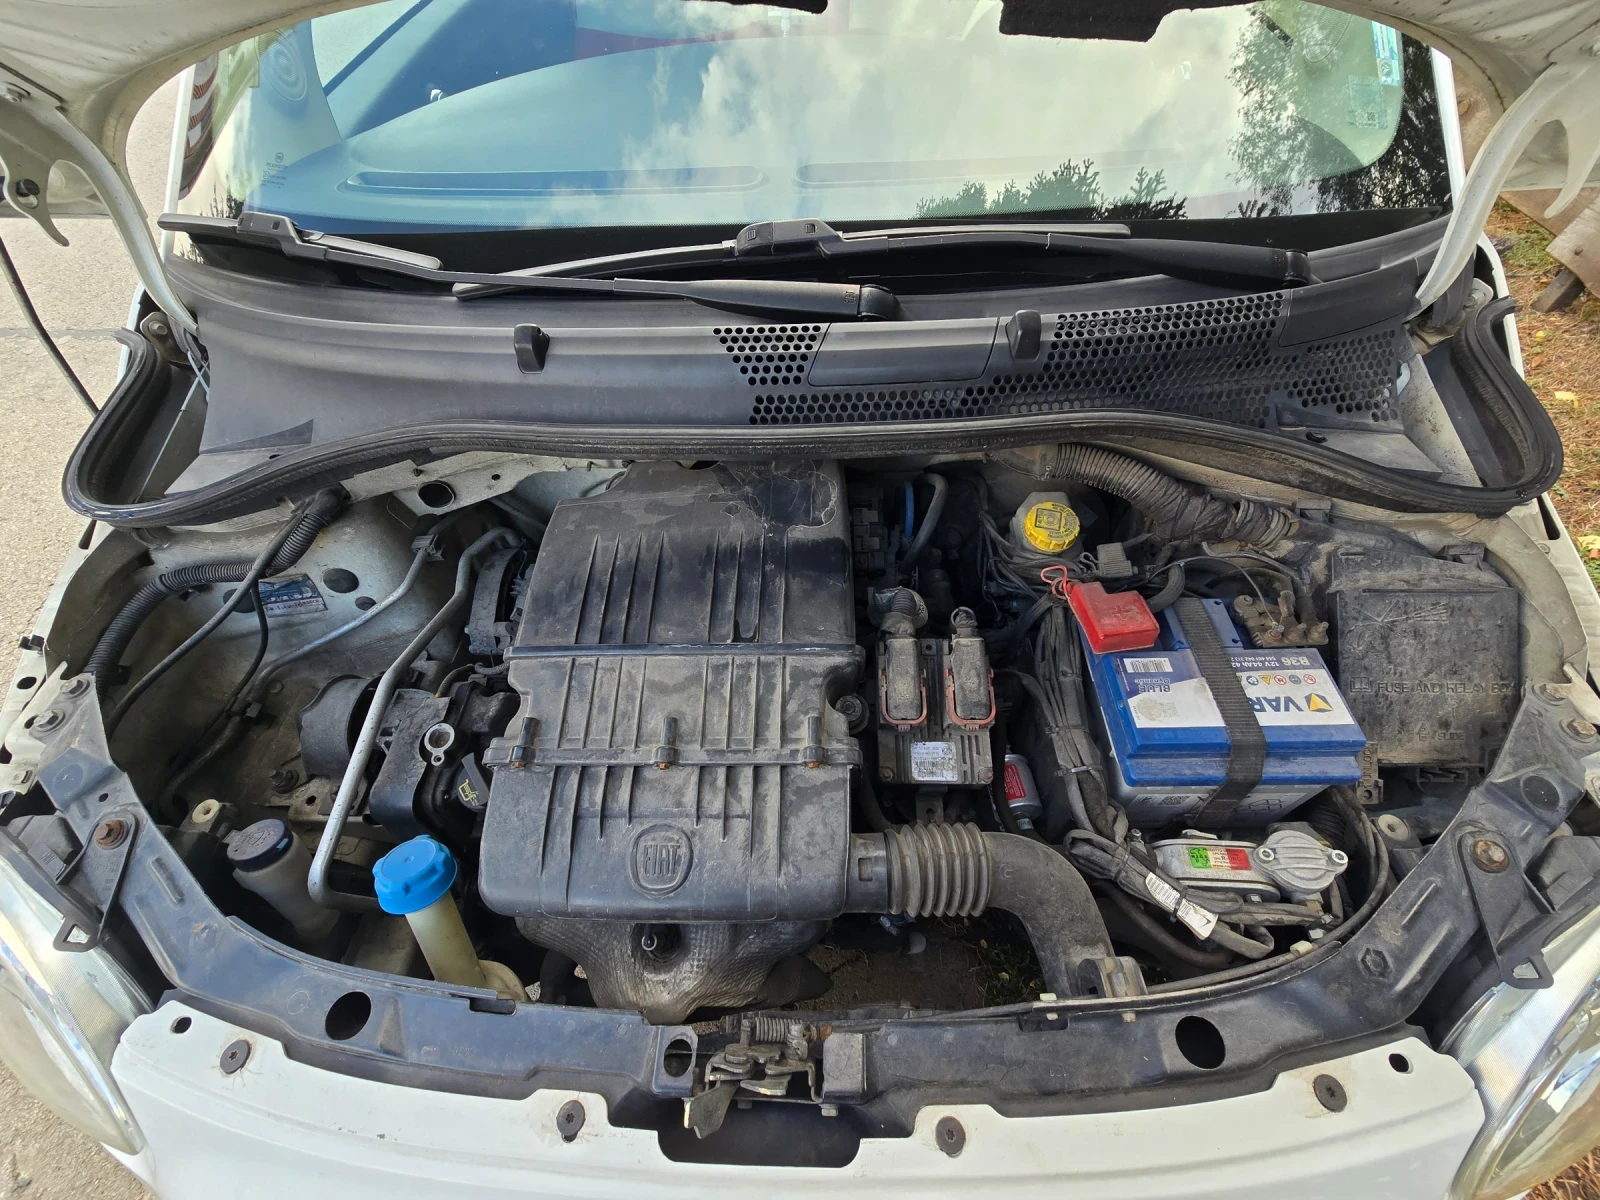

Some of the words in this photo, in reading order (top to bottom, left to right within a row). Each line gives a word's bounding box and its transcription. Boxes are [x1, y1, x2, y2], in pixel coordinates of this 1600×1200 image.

[1281, 656, 1311, 666] B36
[1134, 676, 1171, 684] Dynamic
[1138, 684, 1171, 693] BLUE
[1378, 682, 1410, 694] FUSE
[1414, 682, 1441, 694] AND
[1446, 682, 1487, 694] RELAY
[1491, 682, 1515, 694] BOX
[1246, 696, 1304, 713] VAR
[1437, 731, 1465, 741] SLIDE
[642, 844, 680, 875] FIAT
